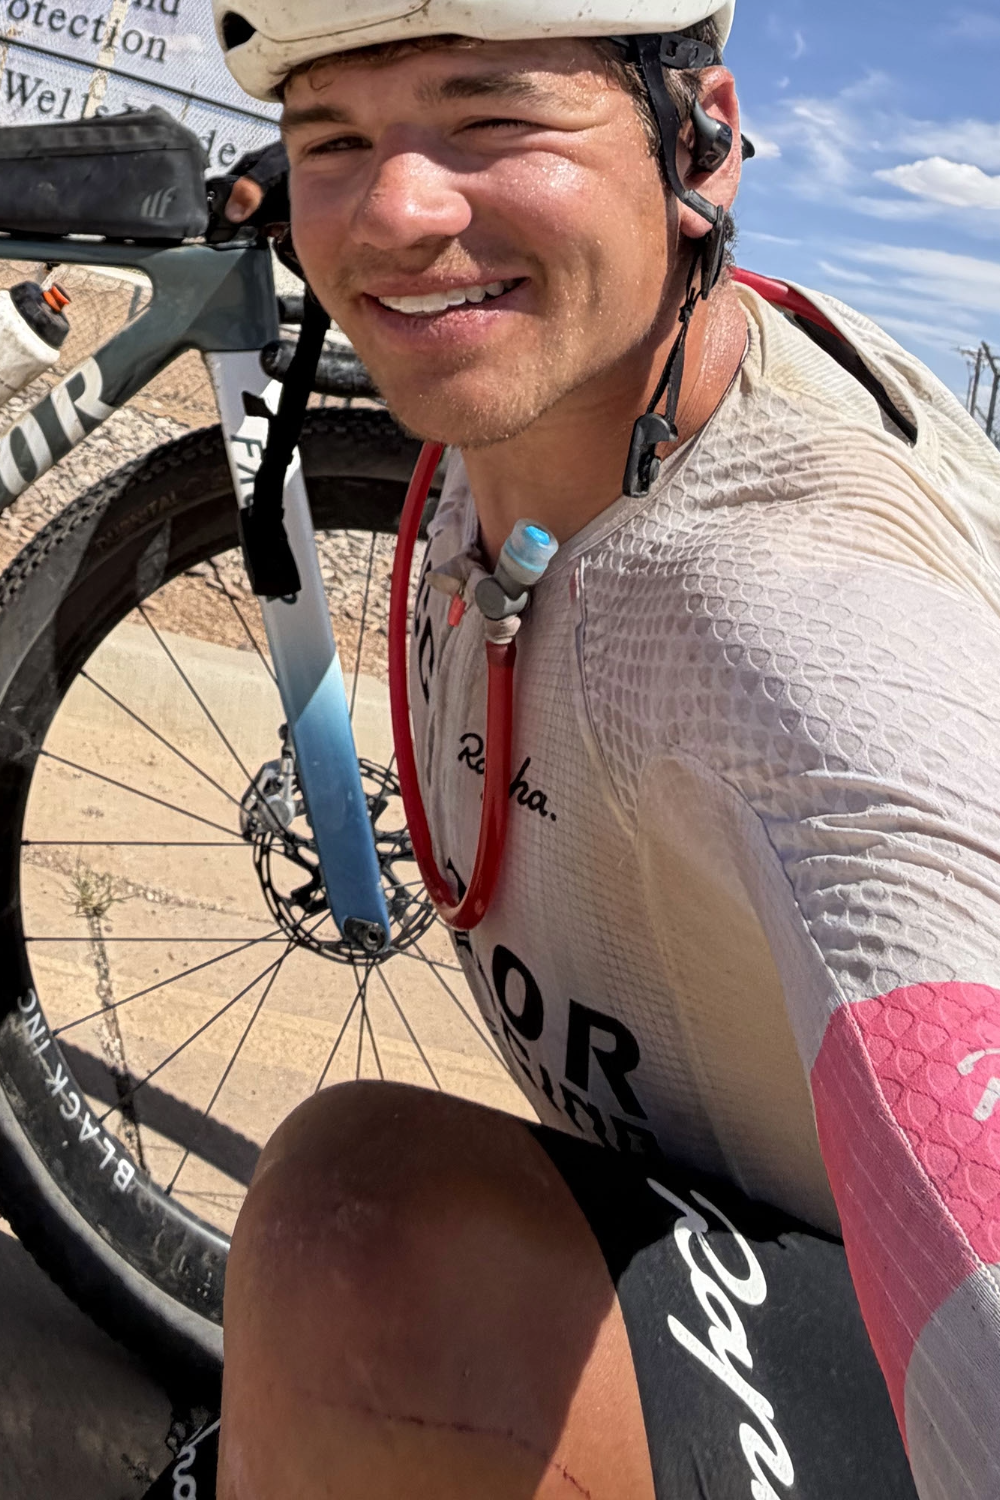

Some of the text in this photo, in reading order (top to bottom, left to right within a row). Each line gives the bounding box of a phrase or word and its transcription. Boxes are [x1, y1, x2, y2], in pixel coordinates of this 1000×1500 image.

[457, 732, 557, 822] Raha.
[18, 988, 135, 1192] BLACK INC
